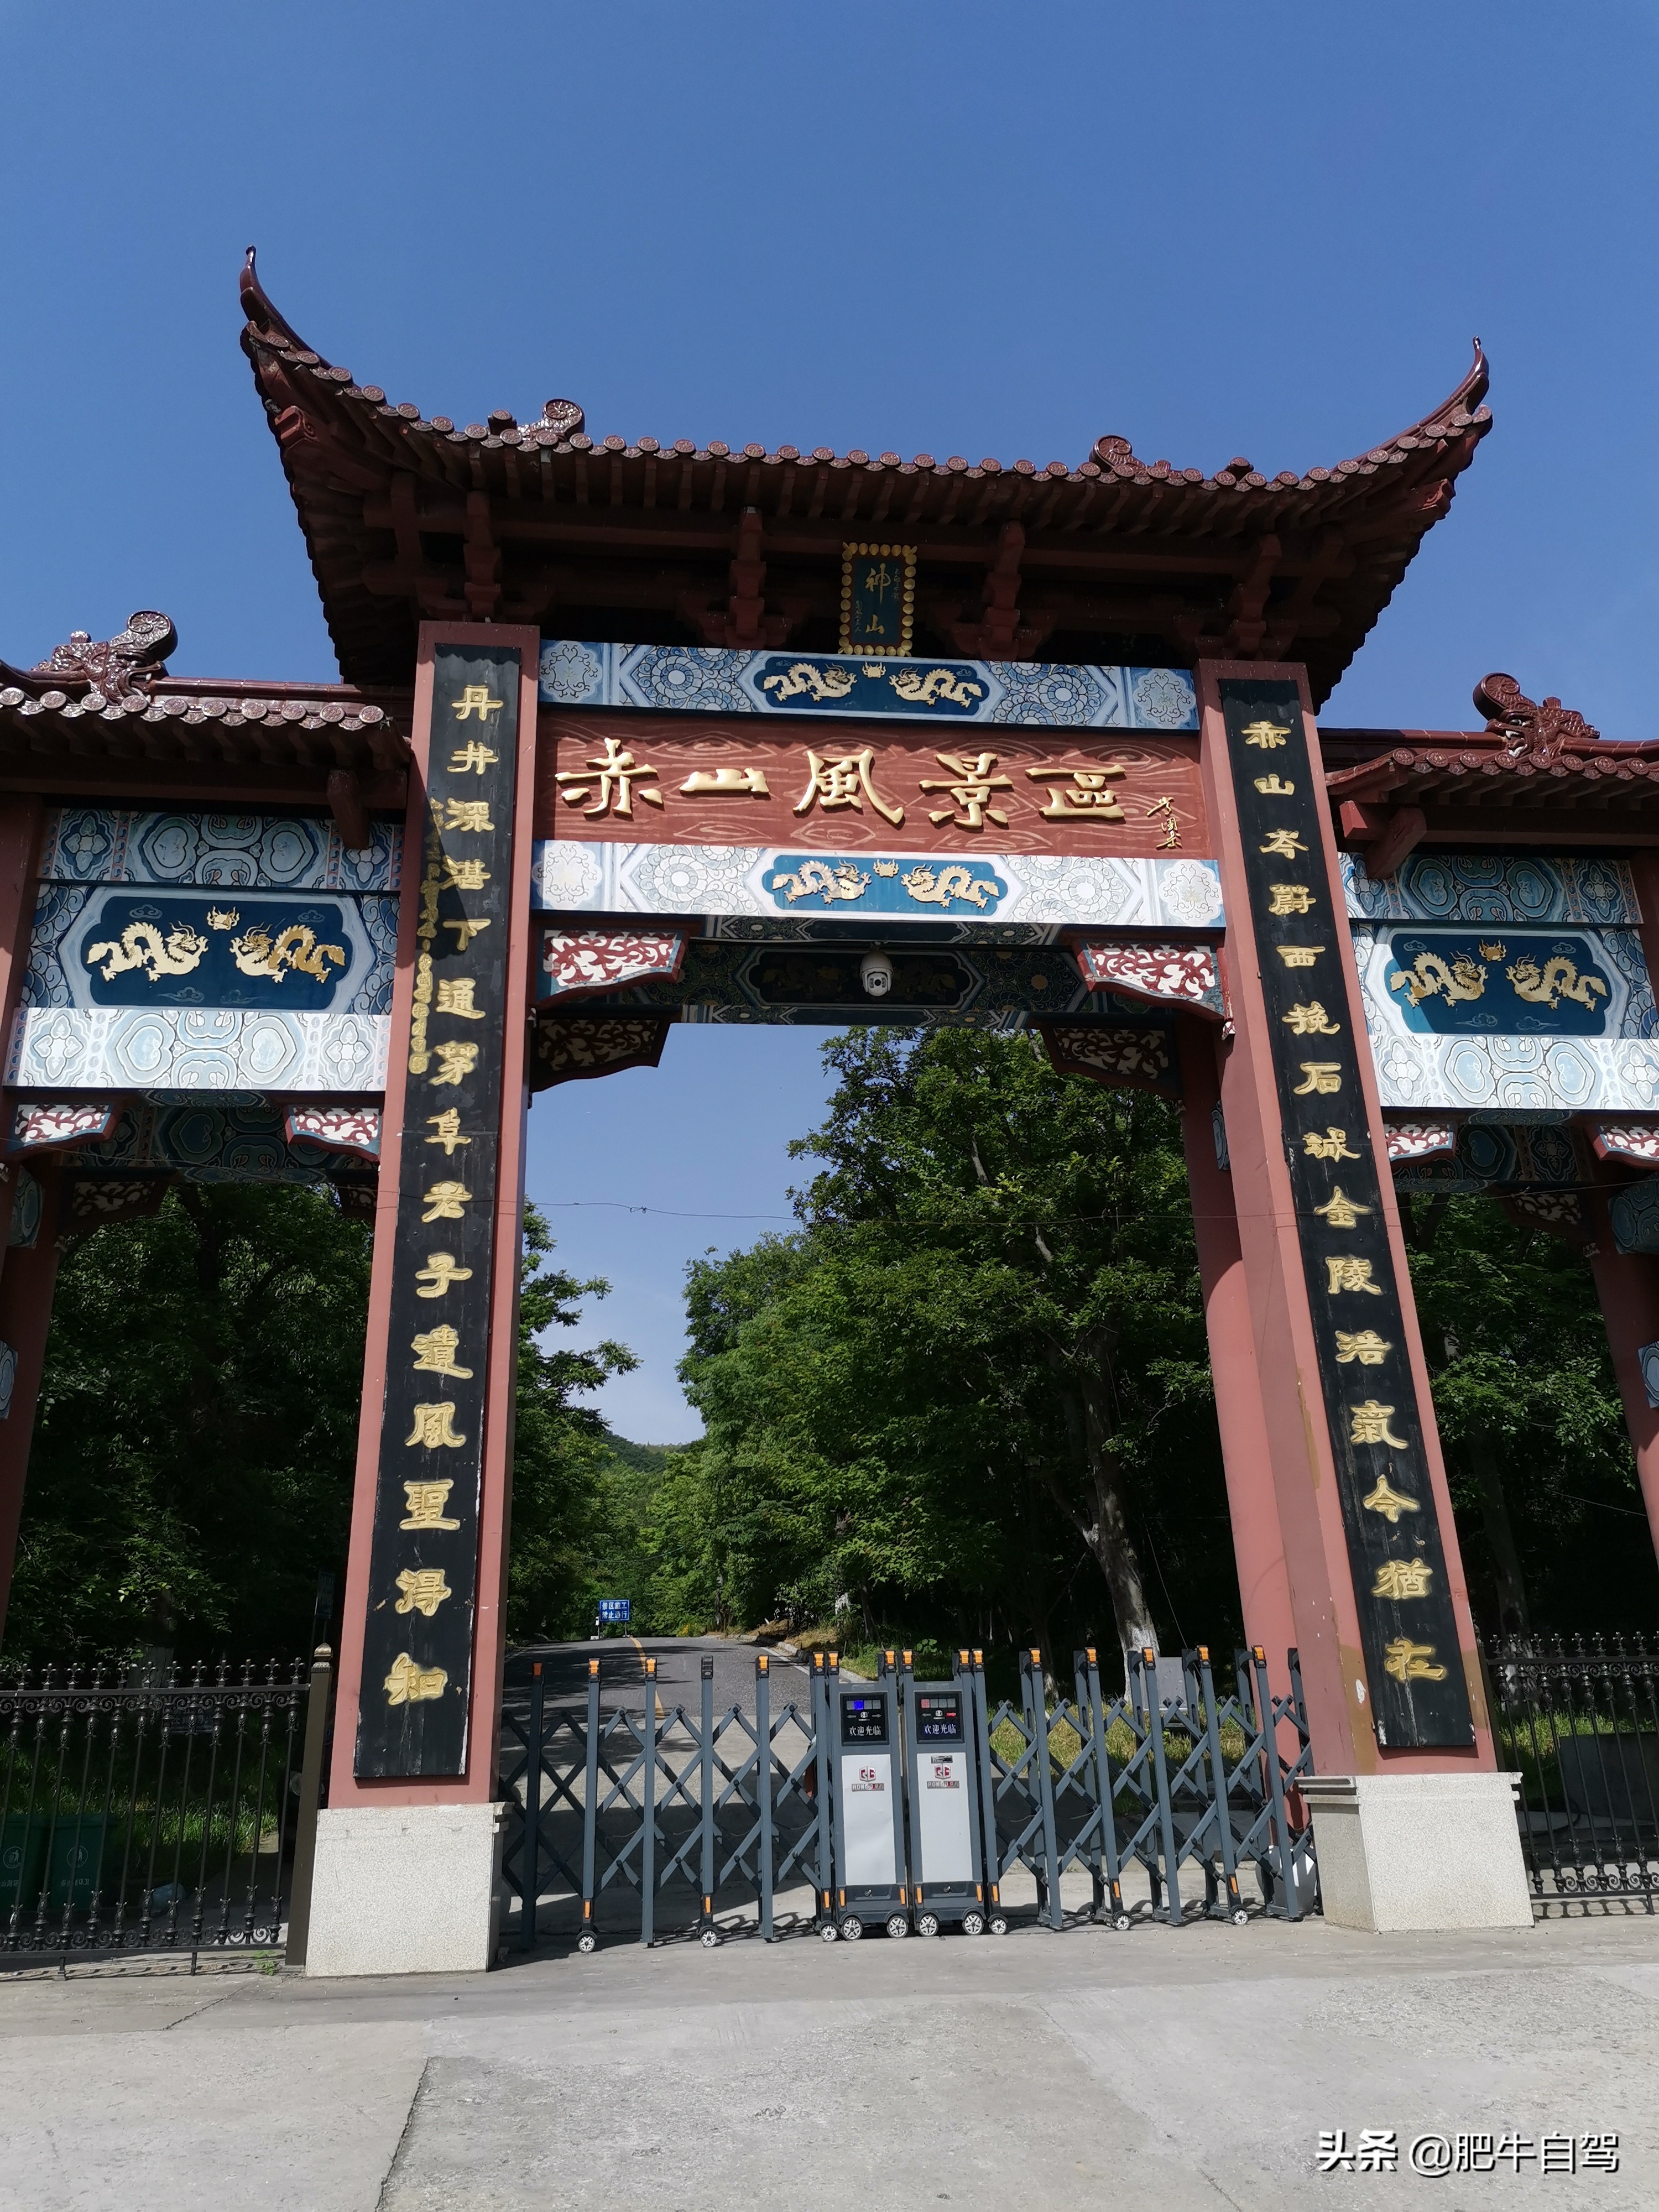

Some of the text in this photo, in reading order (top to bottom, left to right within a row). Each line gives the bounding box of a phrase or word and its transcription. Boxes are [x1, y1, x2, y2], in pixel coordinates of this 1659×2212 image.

[555, 737, 1127, 830] 赤山風景區
[602, 1610, 627, 1619] 禁止通行
[848, 1725, 881, 1736] 欢迎光临
[924, 1723, 956, 1735] 欢迎光临
